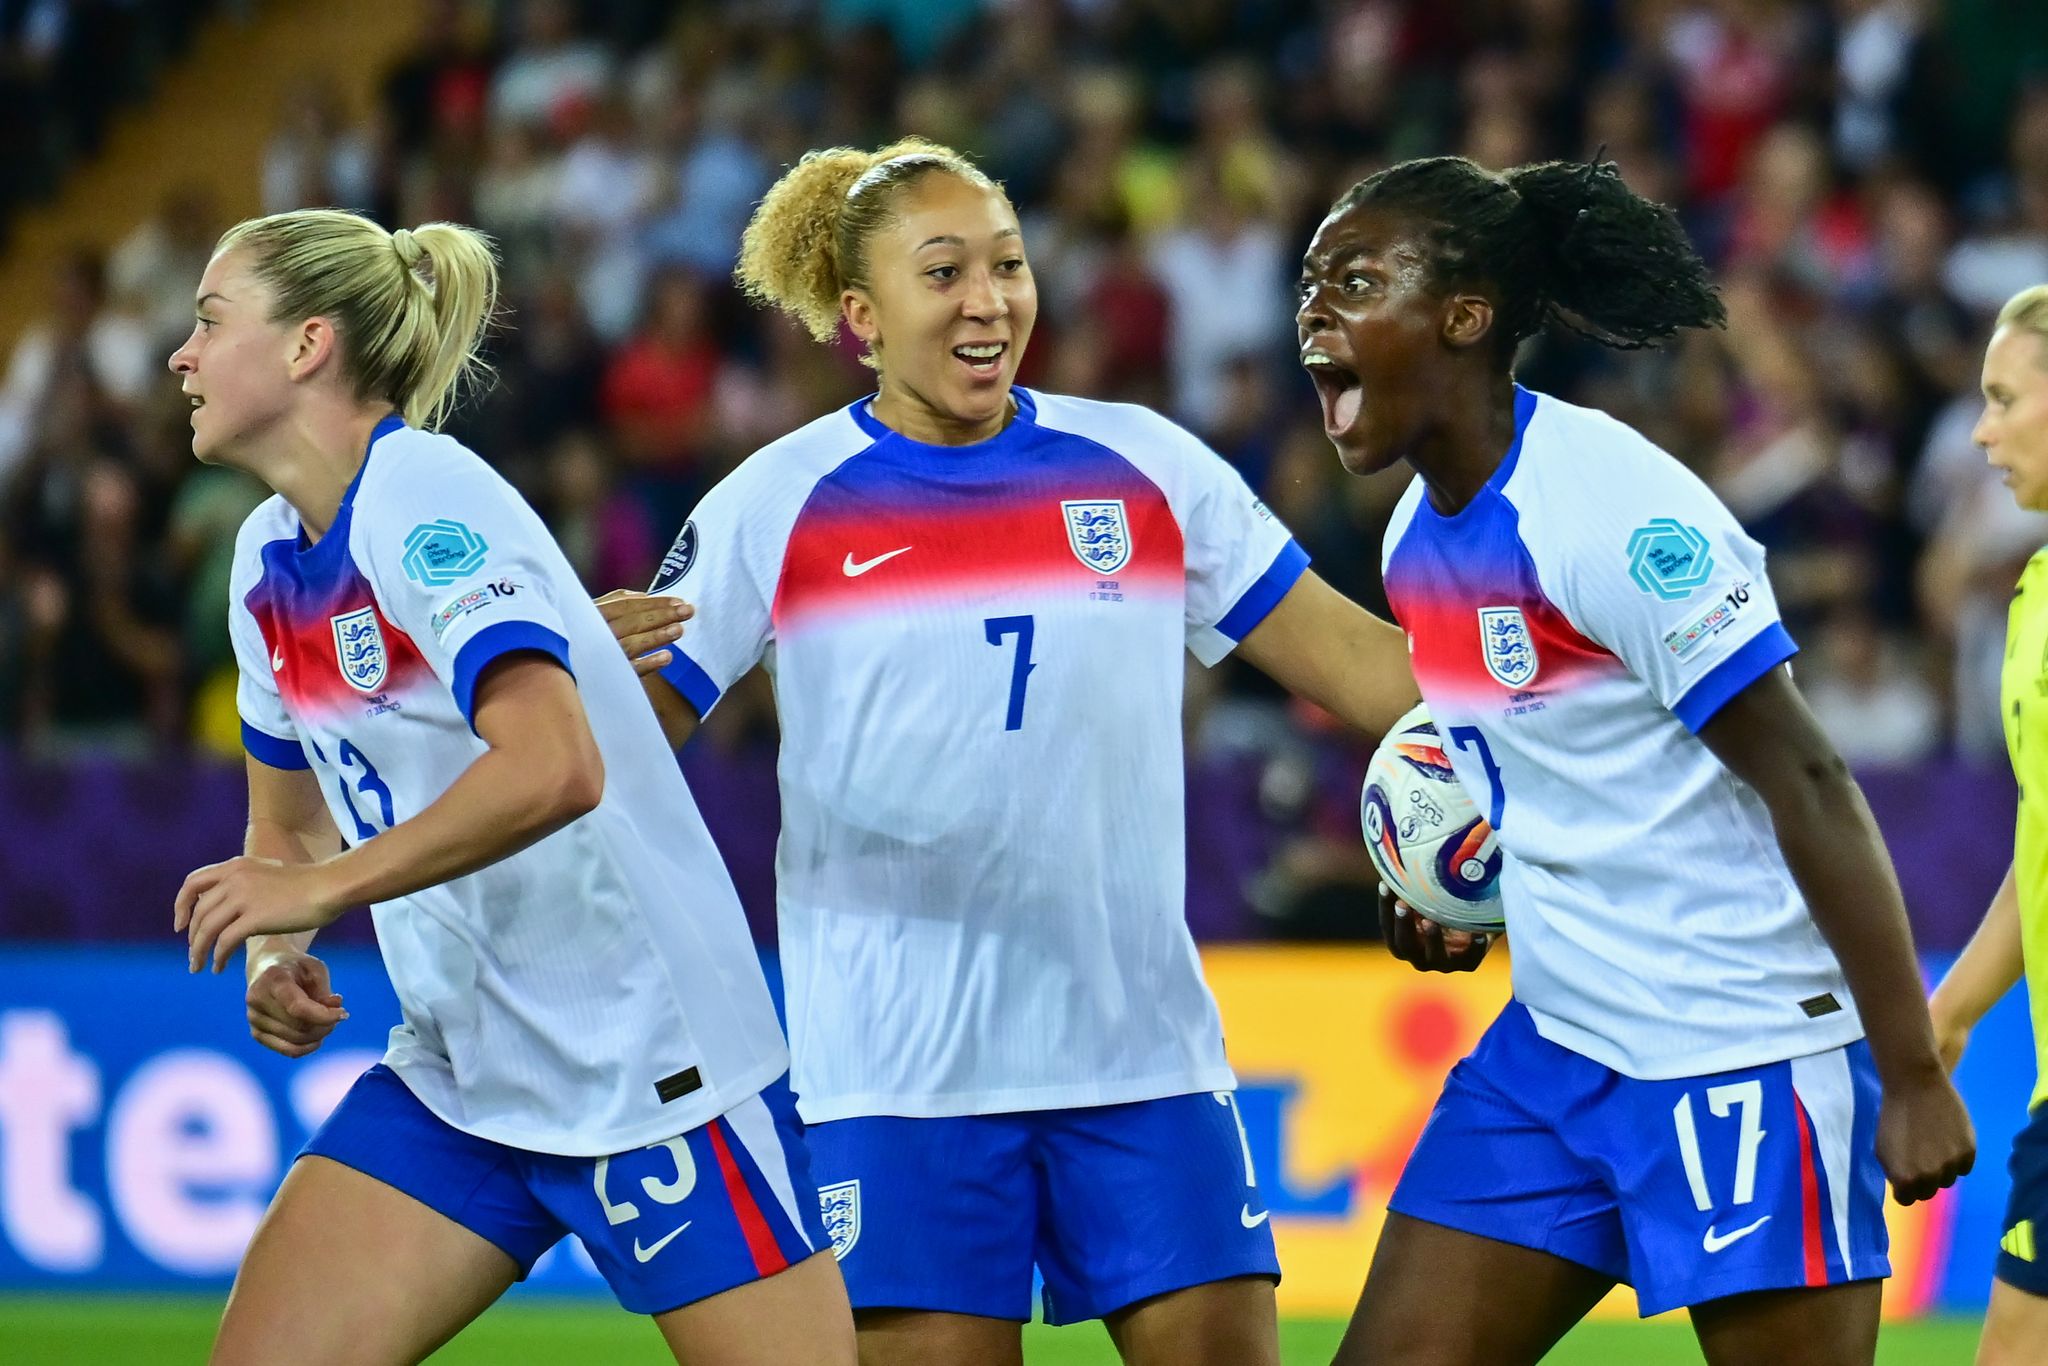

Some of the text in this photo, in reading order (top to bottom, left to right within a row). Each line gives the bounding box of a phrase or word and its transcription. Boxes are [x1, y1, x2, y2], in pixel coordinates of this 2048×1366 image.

[984, 614, 1037, 731] 7
[1670, 606, 1731, 653] FOUNDATION
[1673, 1080, 1767, 1212] 17
